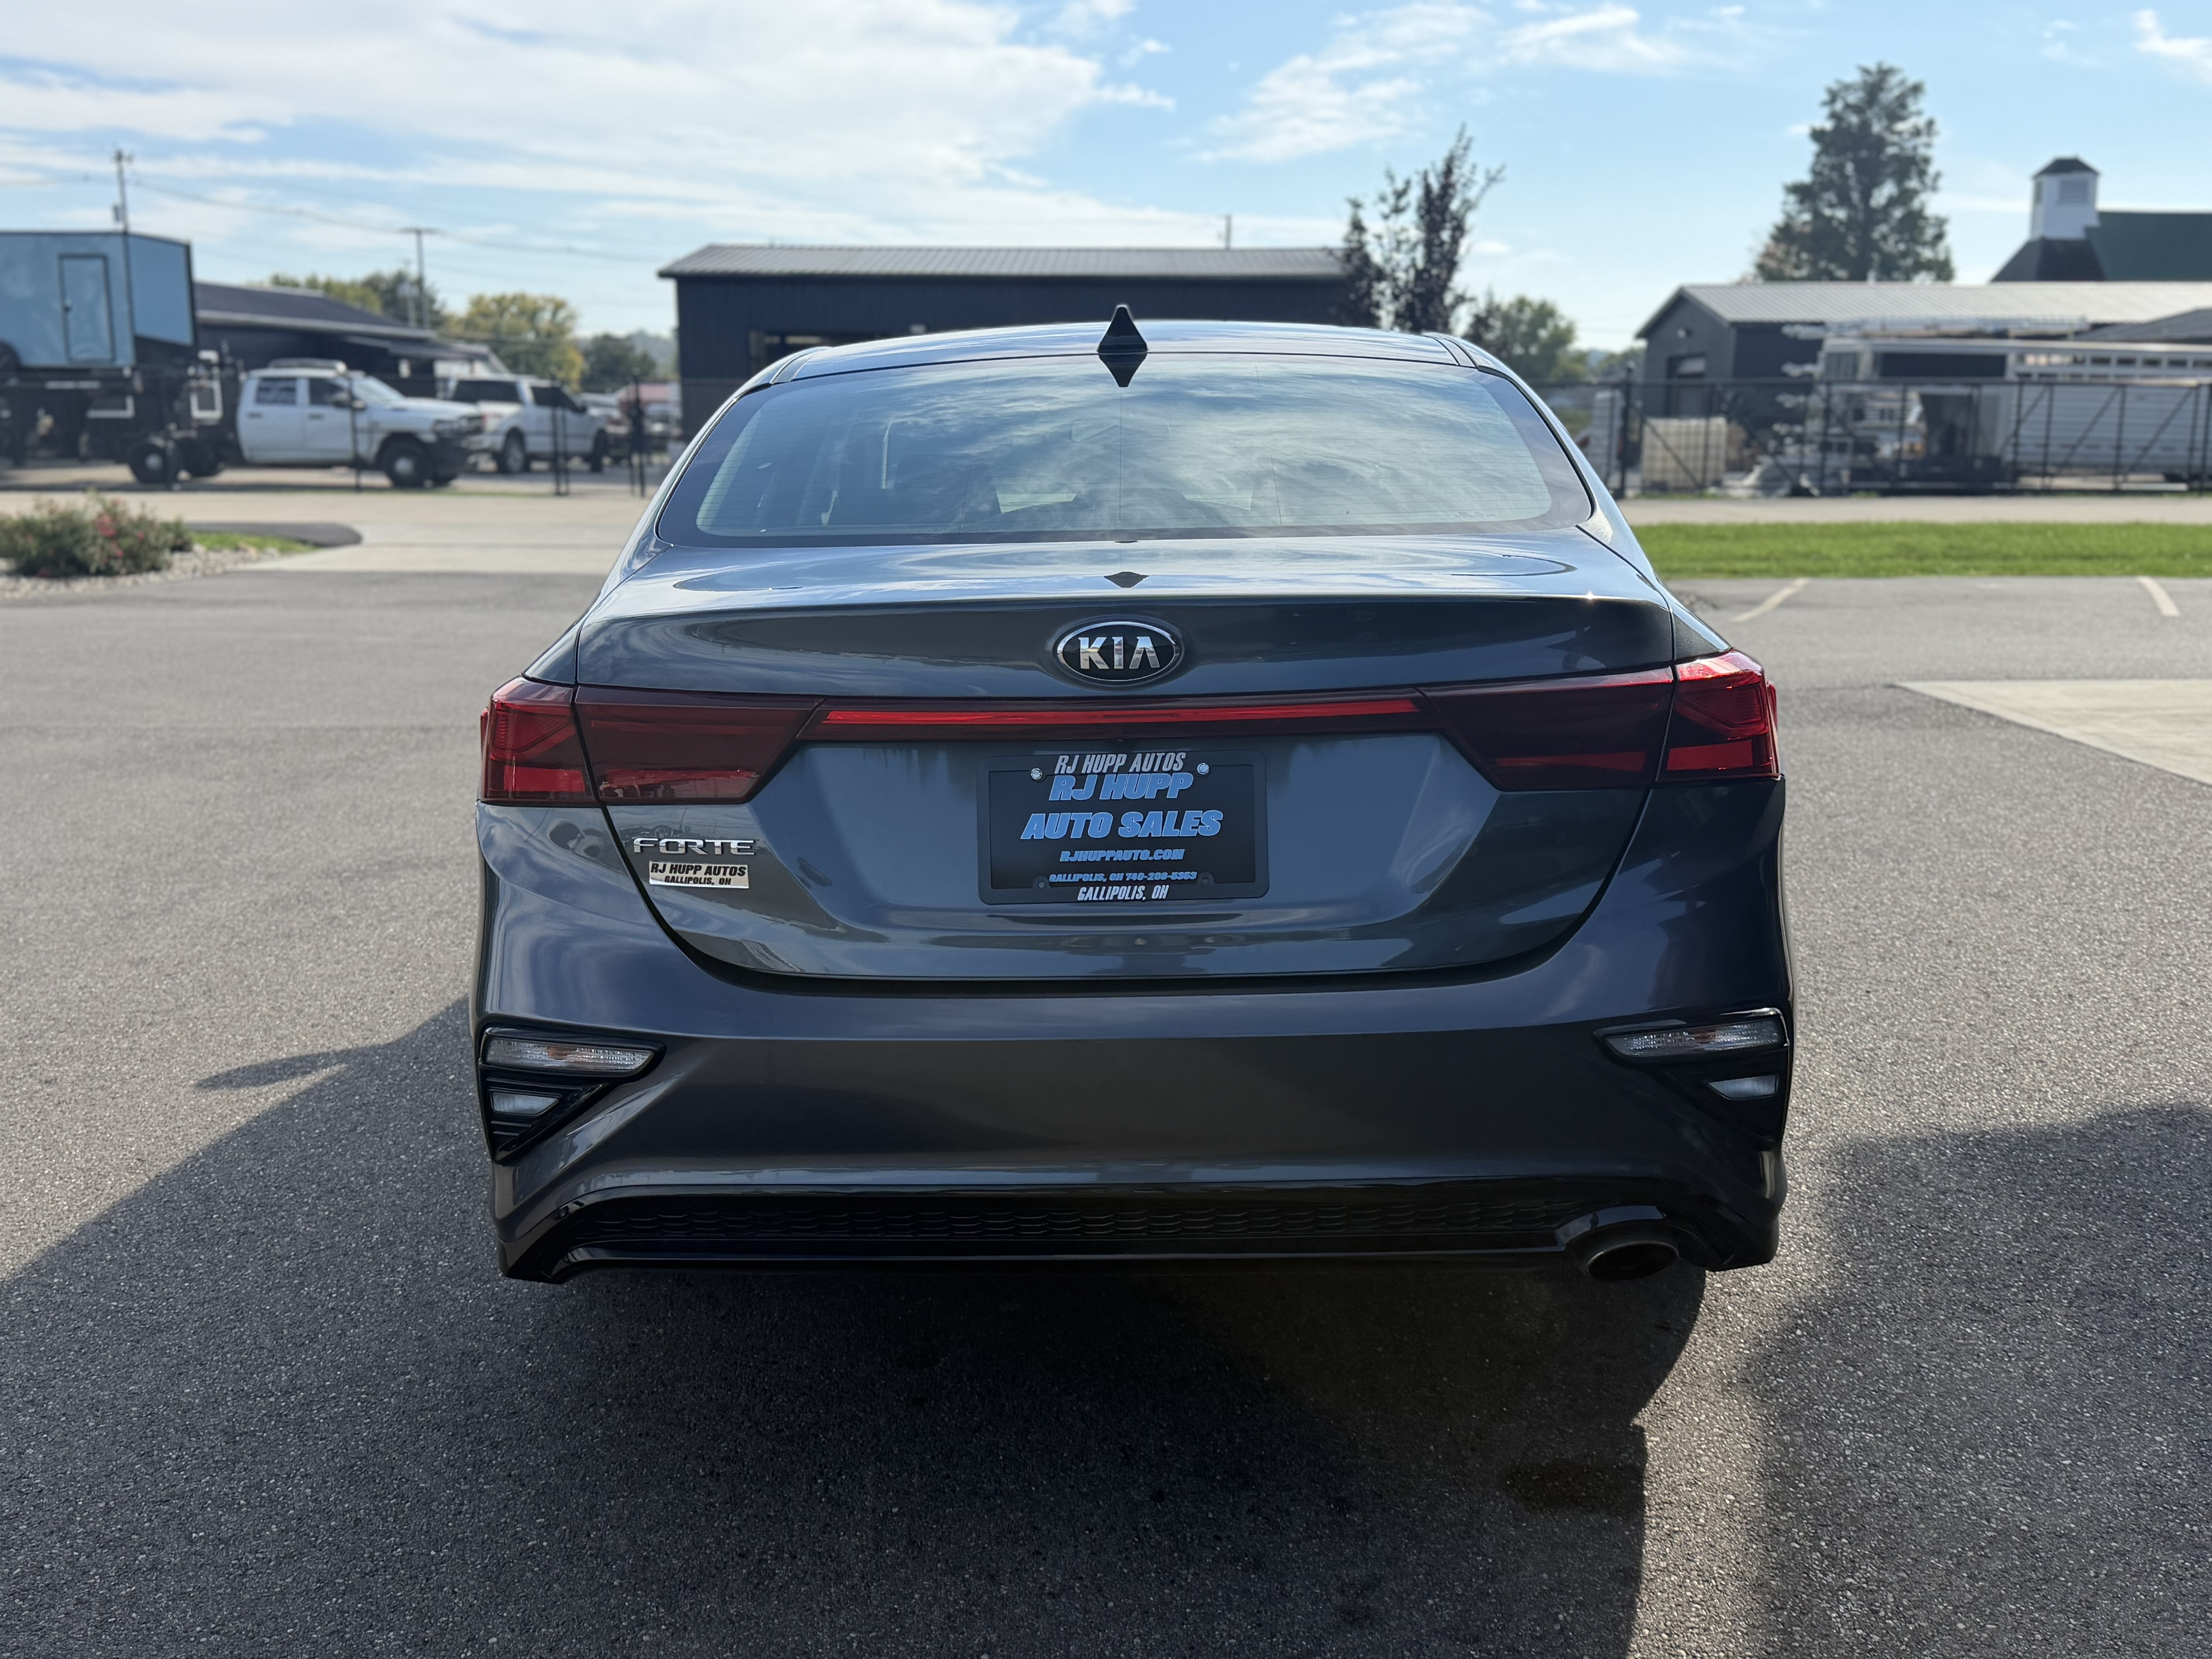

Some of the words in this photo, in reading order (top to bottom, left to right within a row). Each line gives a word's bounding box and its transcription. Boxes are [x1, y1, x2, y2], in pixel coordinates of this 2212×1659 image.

[1079, 636, 1160, 669] KIA
[1054, 755, 1079, 774] RJ
[1082, 754, 1127, 773] HUPP
[1129, 752, 1187, 772] AUTOS
[1049, 775, 1097, 800] RJ
[1099, 773, 1194, 800] HUPP
[1020, 812, 1113, 839] AUTO
[1118, 810, 1223, 838] SALES
[634, 838, 754, 855] FORTE
[1060, 849, 1185, 862] RJHUPPAUTO.COM
[651, 863, 666, 873] RJ
[669, 864, 702, 875] HUPP
[704, 866, 746, 876] AUTOS
[1049, 873, 1107, 882] GALLIPOLIS,
[1109, 873, 1124, 881] OH
[664, 876, 714, 885] GALLIPOLIS,
[1077, 886, 1146, 900] GALLIPOLIS,
[1151, 885, 1169, 899] OH
